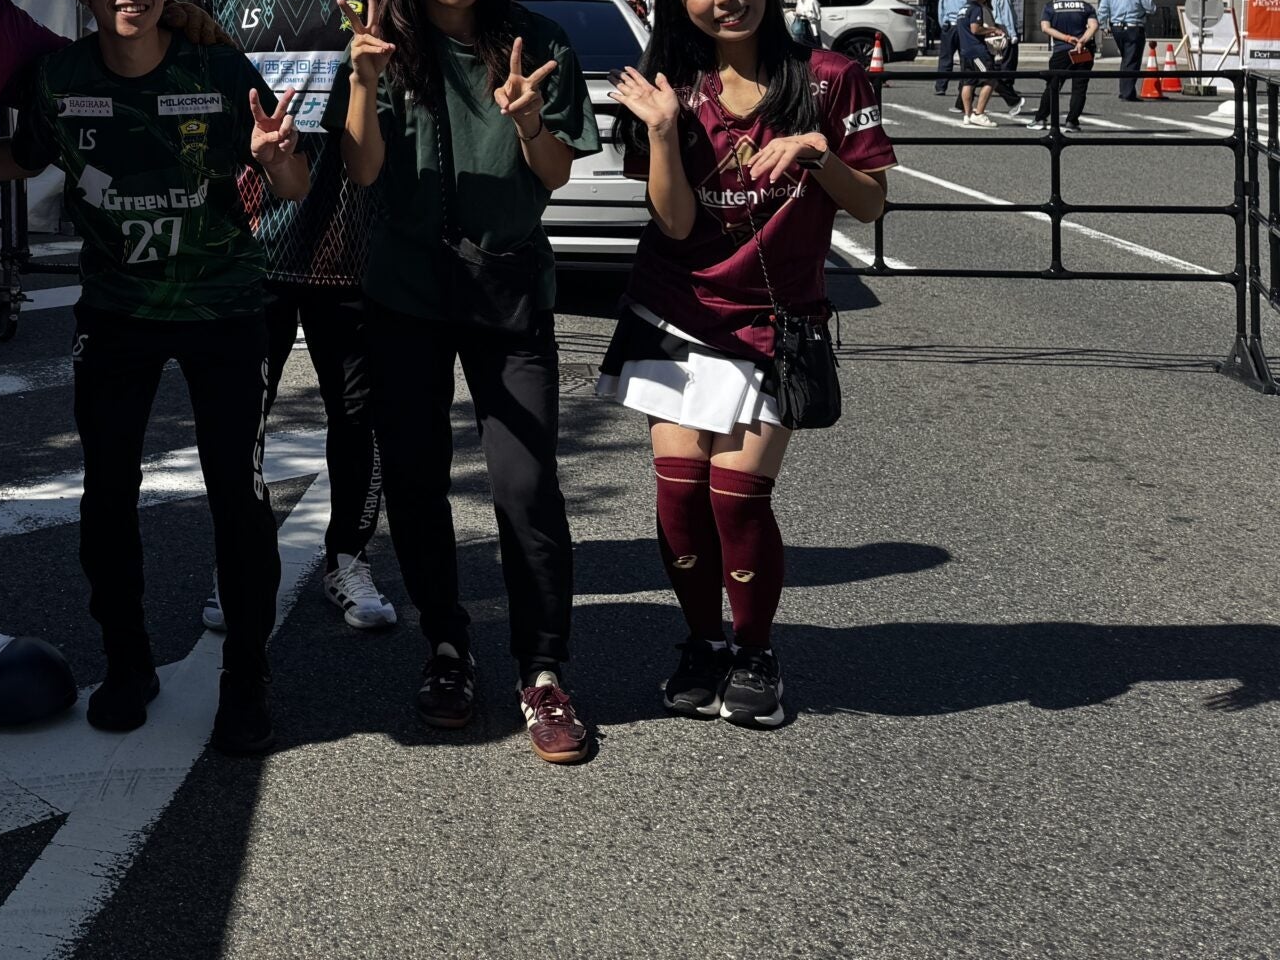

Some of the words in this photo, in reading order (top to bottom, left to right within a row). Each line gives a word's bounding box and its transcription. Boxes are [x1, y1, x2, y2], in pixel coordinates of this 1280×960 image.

[264, 59, 340, 74] 西宮回生病
[160, 96, 220, 106] MILKCROWN
[122, 217, 183, 263] 27
